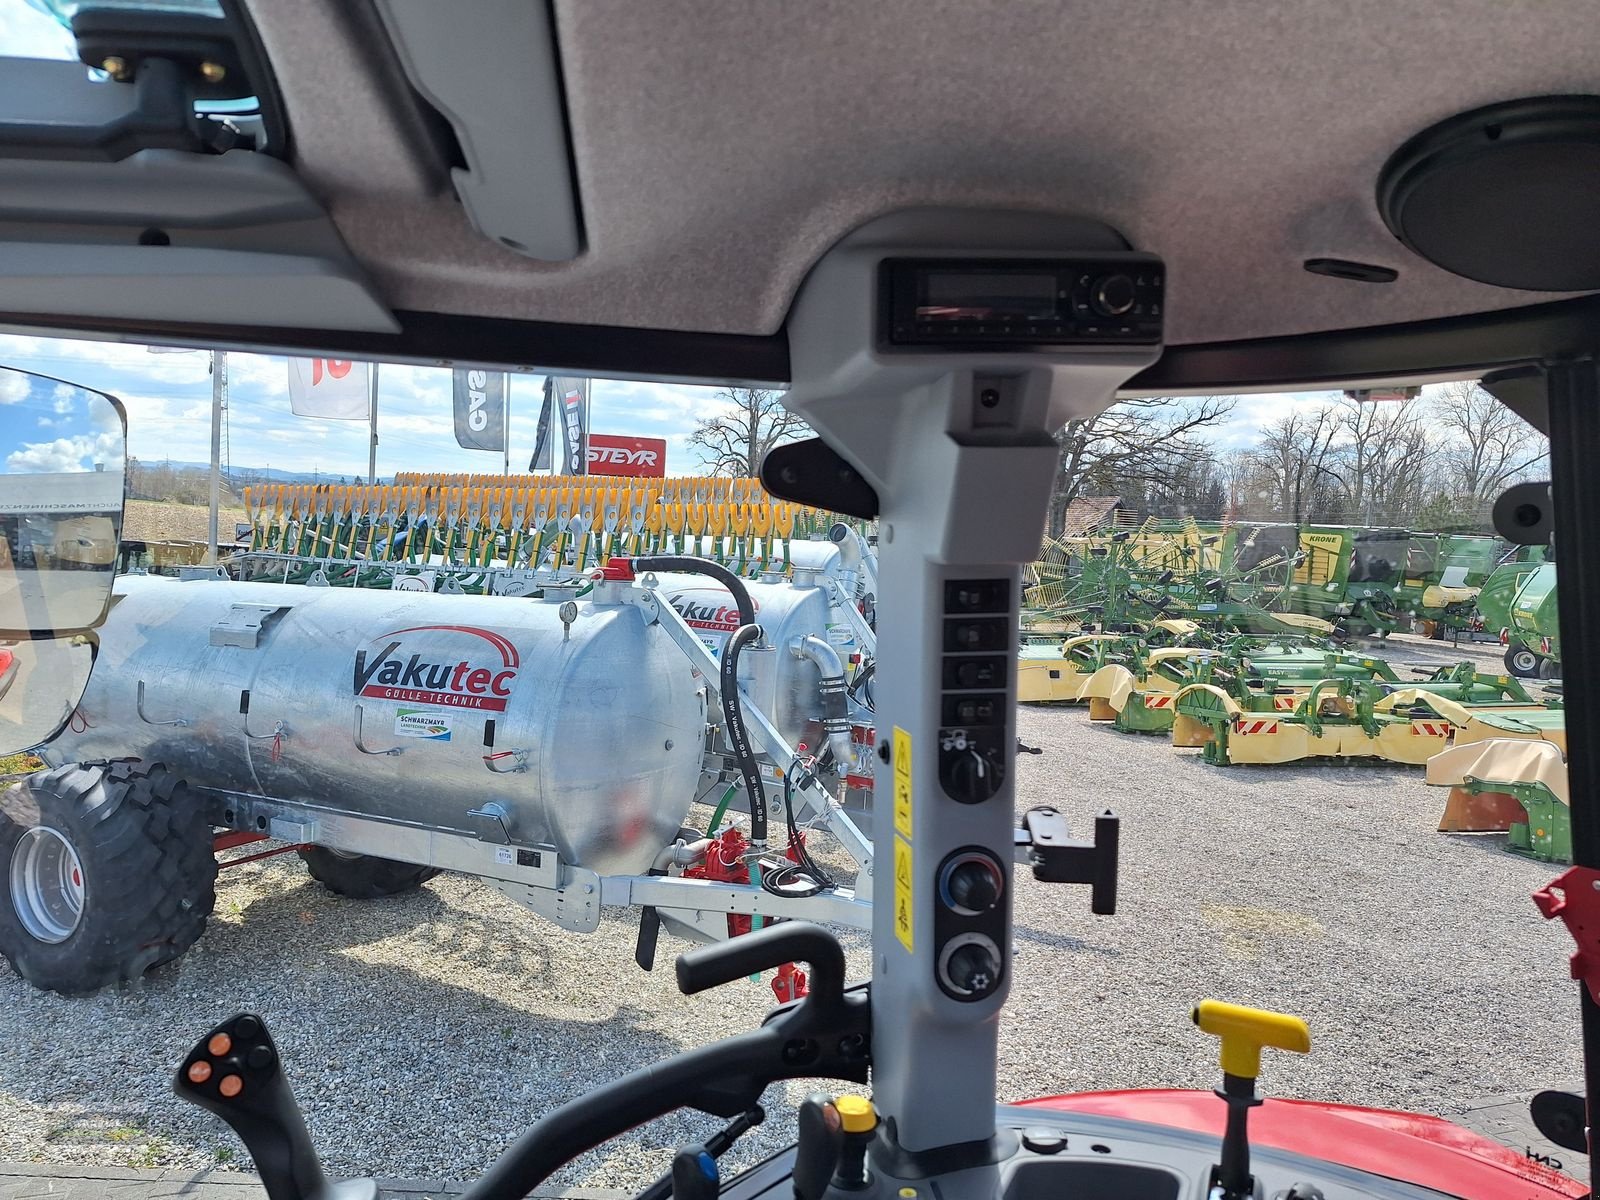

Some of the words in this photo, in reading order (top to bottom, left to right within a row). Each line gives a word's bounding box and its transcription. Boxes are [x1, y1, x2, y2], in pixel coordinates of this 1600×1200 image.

[586, 446, 657, 467] STEYR
[1309, 535, 1337, 543] KRONE
[669, 595, 741, 623] akute
[353, 641, 516, 697] Vakutec
[385, 688, 483, 707] GÜLLE-TECHNIK
[728, 700, 735, 711] SW
[400, 715, 445, 726] SCHWARZMAYR
[731, 715, 742, 741] Vakutec
